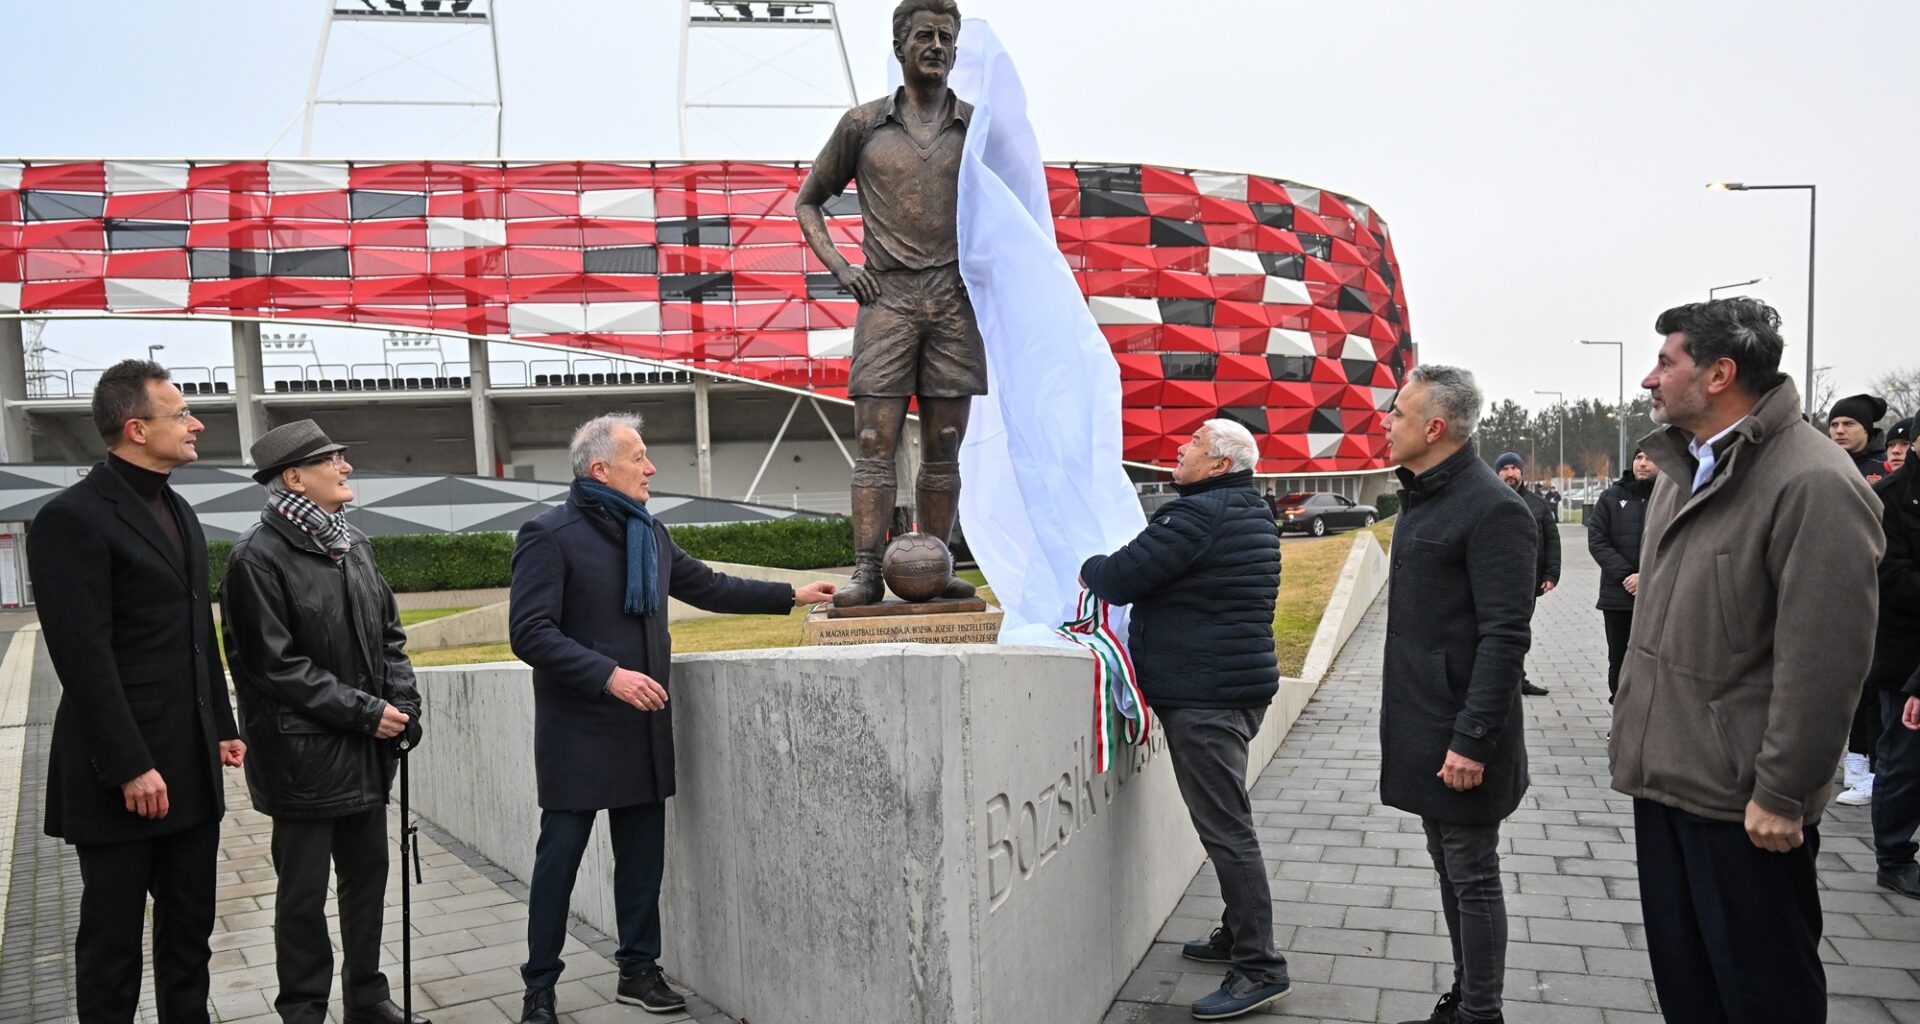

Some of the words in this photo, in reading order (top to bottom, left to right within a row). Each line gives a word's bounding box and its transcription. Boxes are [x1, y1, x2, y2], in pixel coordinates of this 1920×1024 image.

[819, 630, 825, 638] A
[825, 629, 850, 638] MAGYAR
[850, 628, 875, 637] FUTBALL
[912, 625, 933, 634] BOZSIK
[941, 633, 998, 644] KEZDEMÉNYEZÉSÉR
